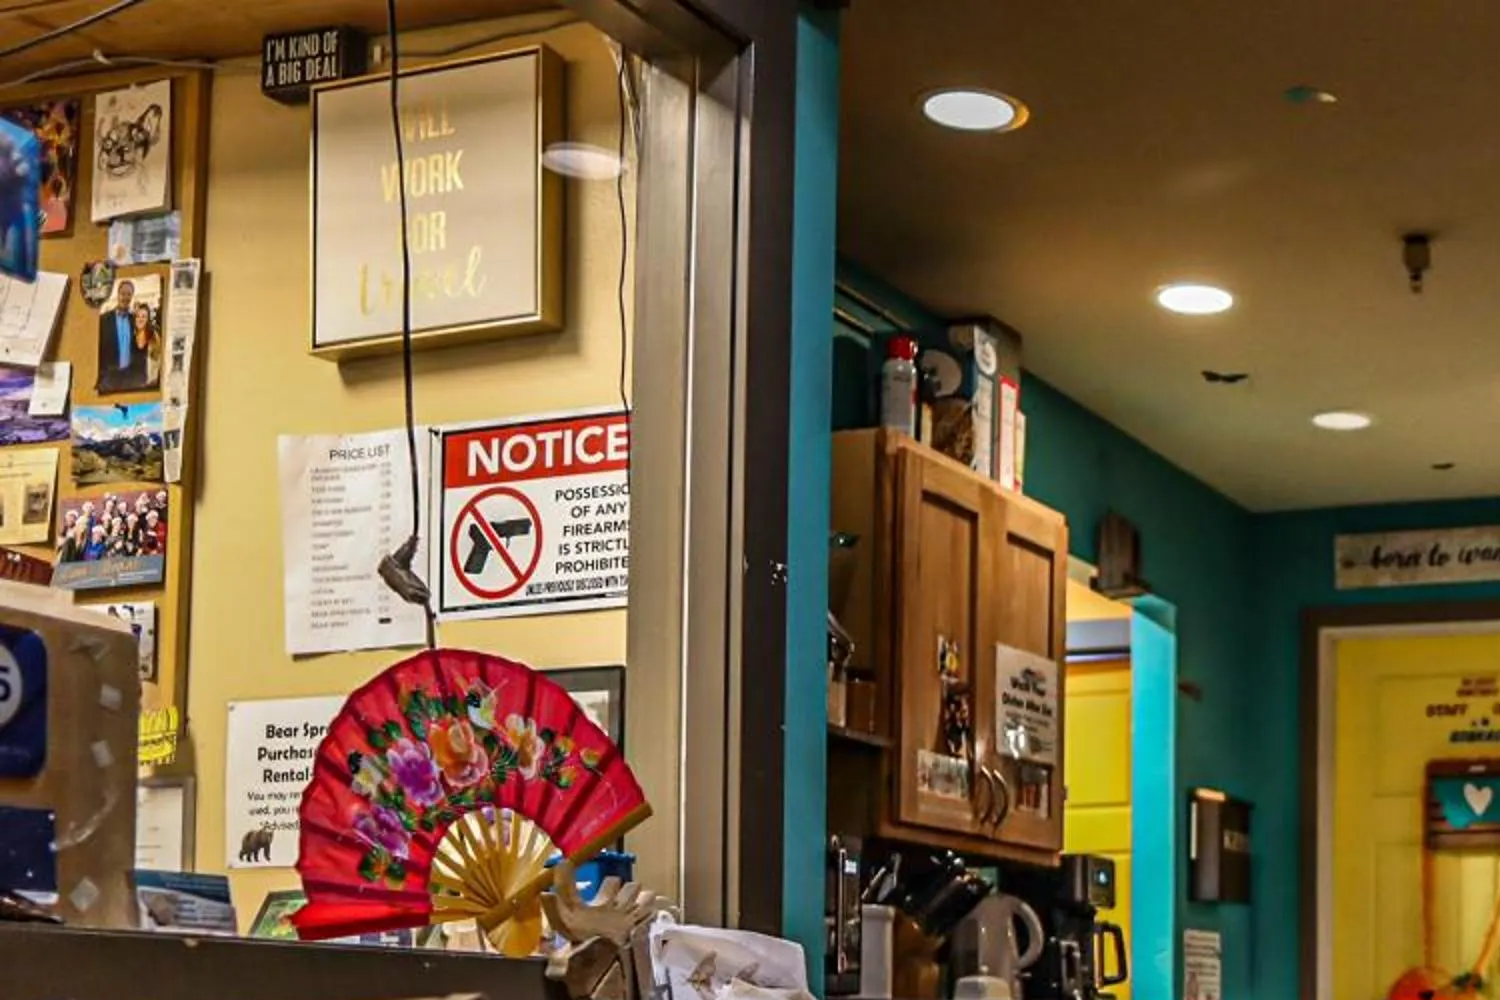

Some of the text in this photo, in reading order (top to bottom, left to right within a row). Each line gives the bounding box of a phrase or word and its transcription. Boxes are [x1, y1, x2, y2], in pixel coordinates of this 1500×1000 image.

[266, 31, 338, 62] I'M KIND OF
[265, 56, 337, 87] A BIG DEAL
[381, 149, 464, 203] WORK
[329, 444, 391, 461] PRICE LIST
[467, 423, 628, 477] NOTICE
[571, 502, 627, 519] OF ANY
[563, 520, 630, 537] FIREARM
[558, 543, 571, 557] IS
[1369, 545, 1421, 570] born
[1427, 543, 1450, 567] to
[265, 722, 329, 739] Bear Spr
[257, 745, 317, 762] Purchas
[247, 791, 265, 801] You
